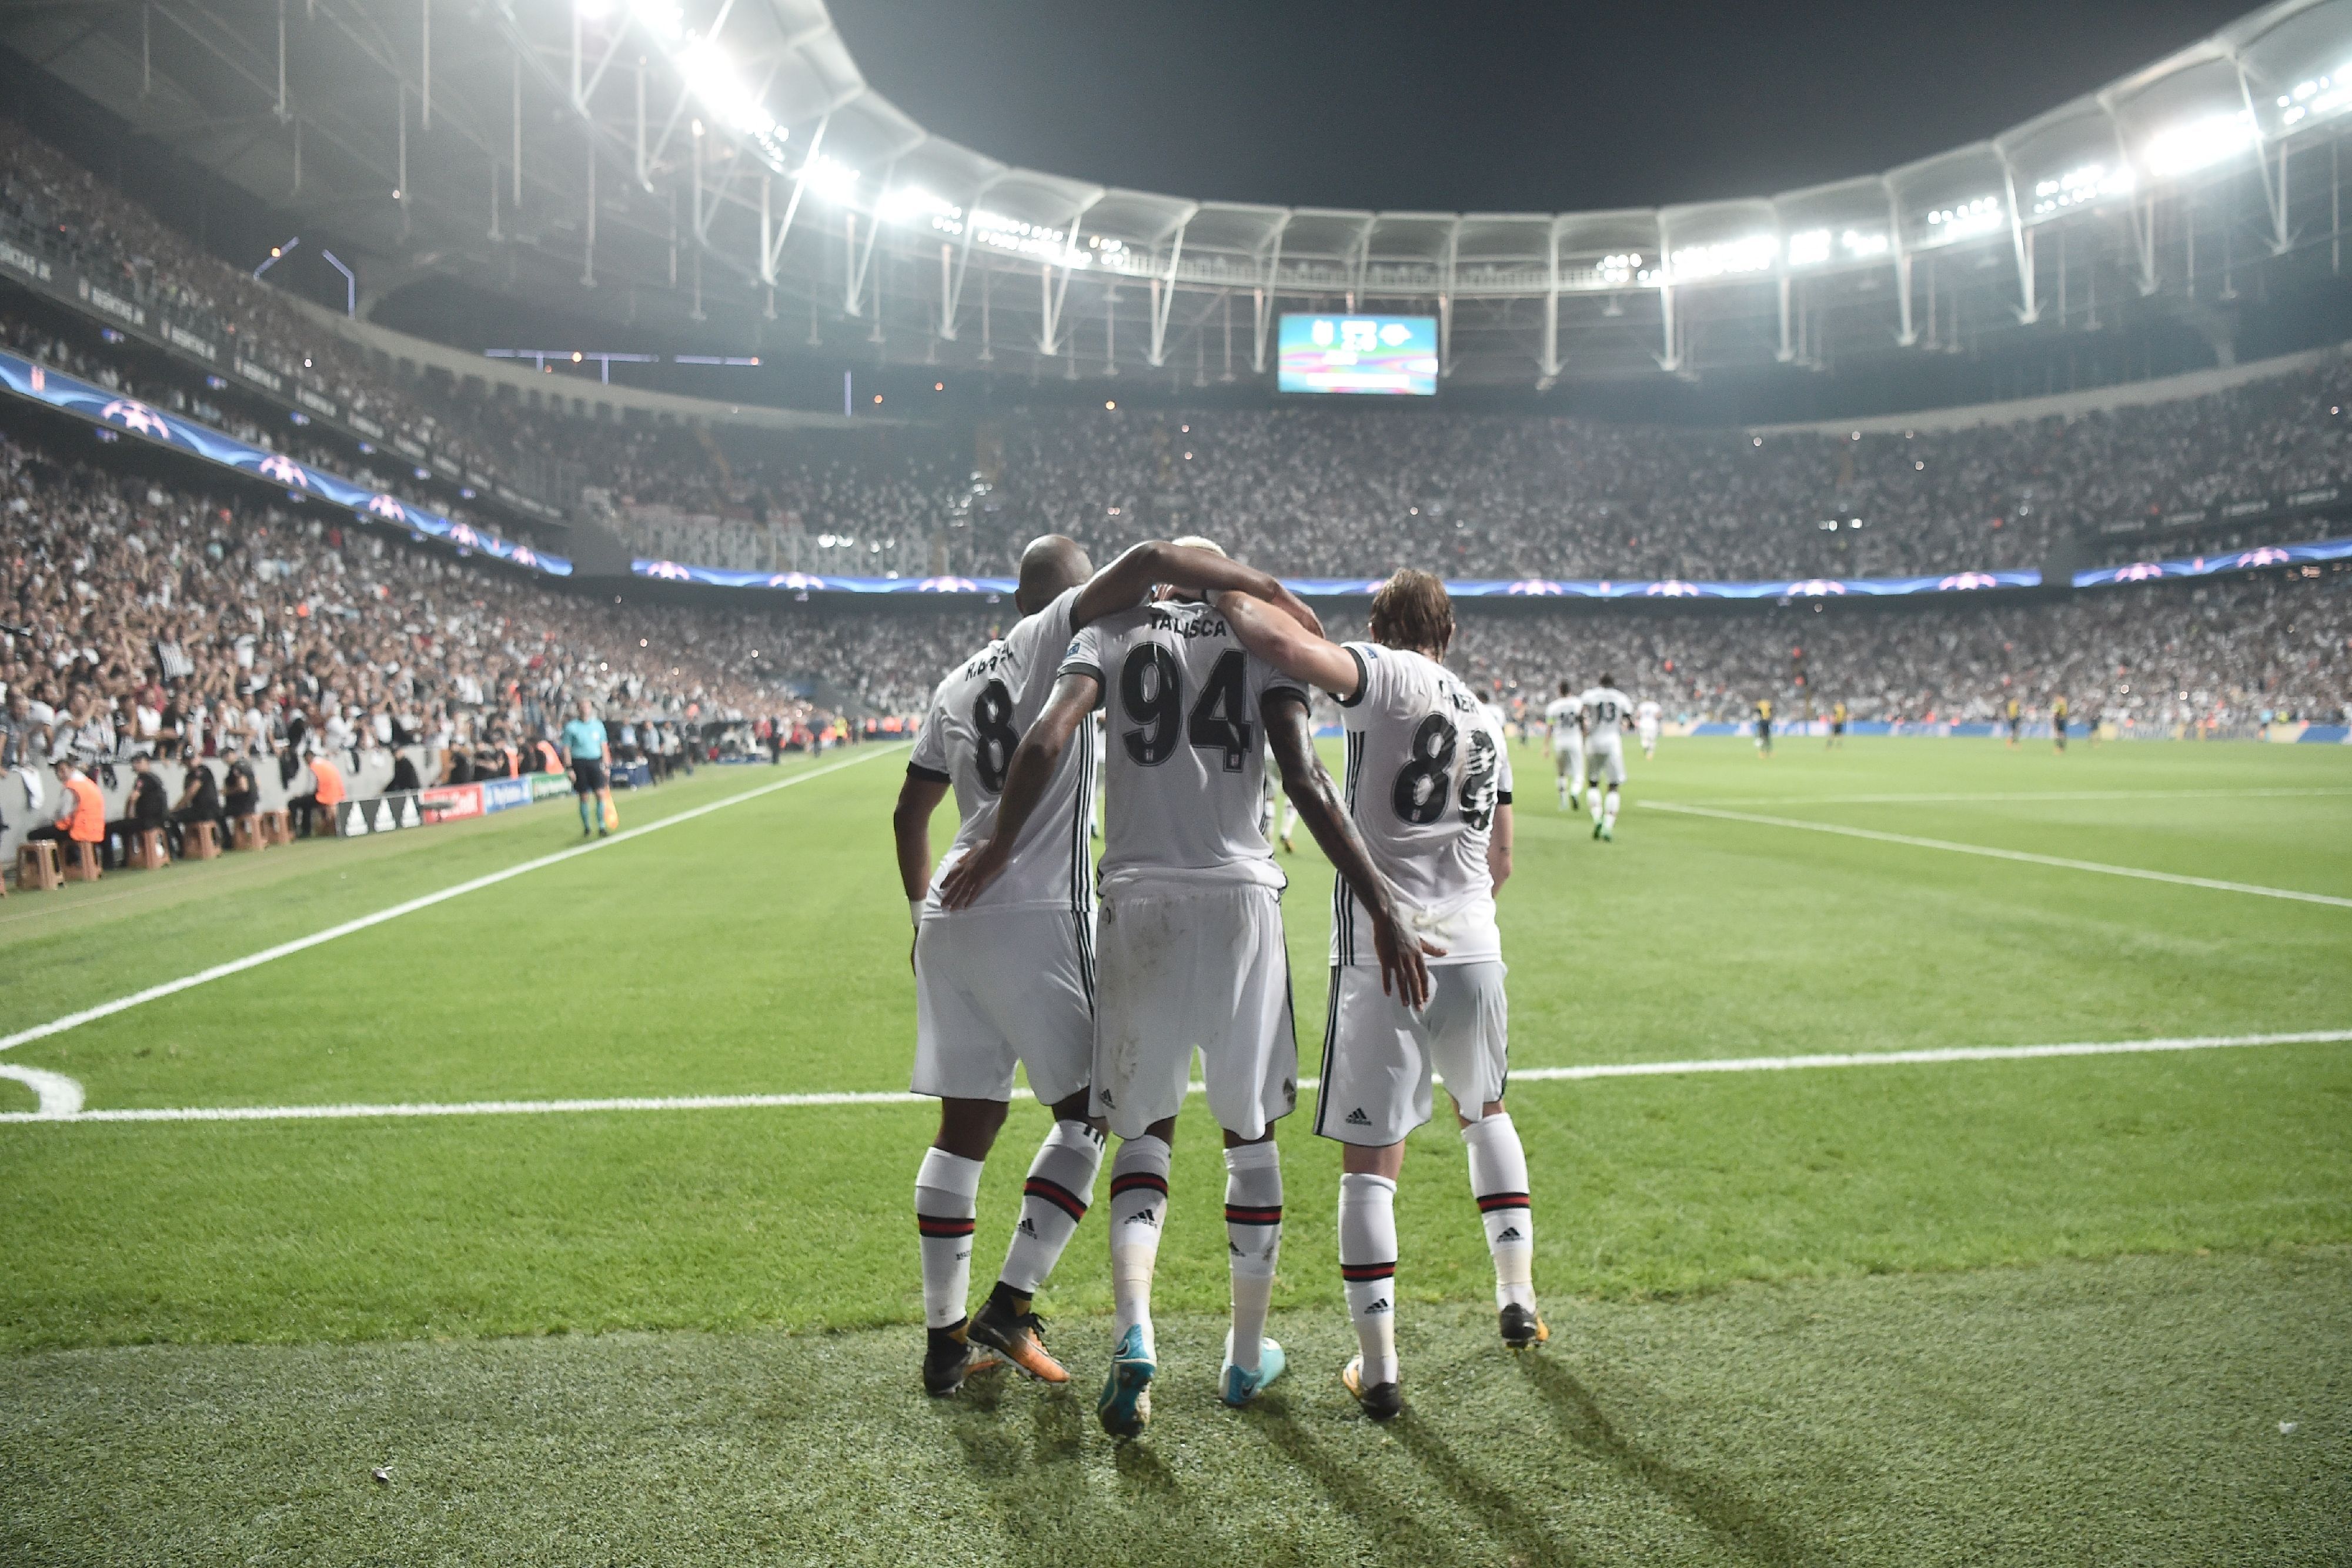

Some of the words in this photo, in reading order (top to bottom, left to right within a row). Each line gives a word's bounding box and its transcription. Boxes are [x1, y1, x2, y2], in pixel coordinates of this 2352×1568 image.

[1151, 613, 1227, 638] TALISCA
[973, 678, 1020, 794] 8
[1120, 641, 1253, 773] 94
